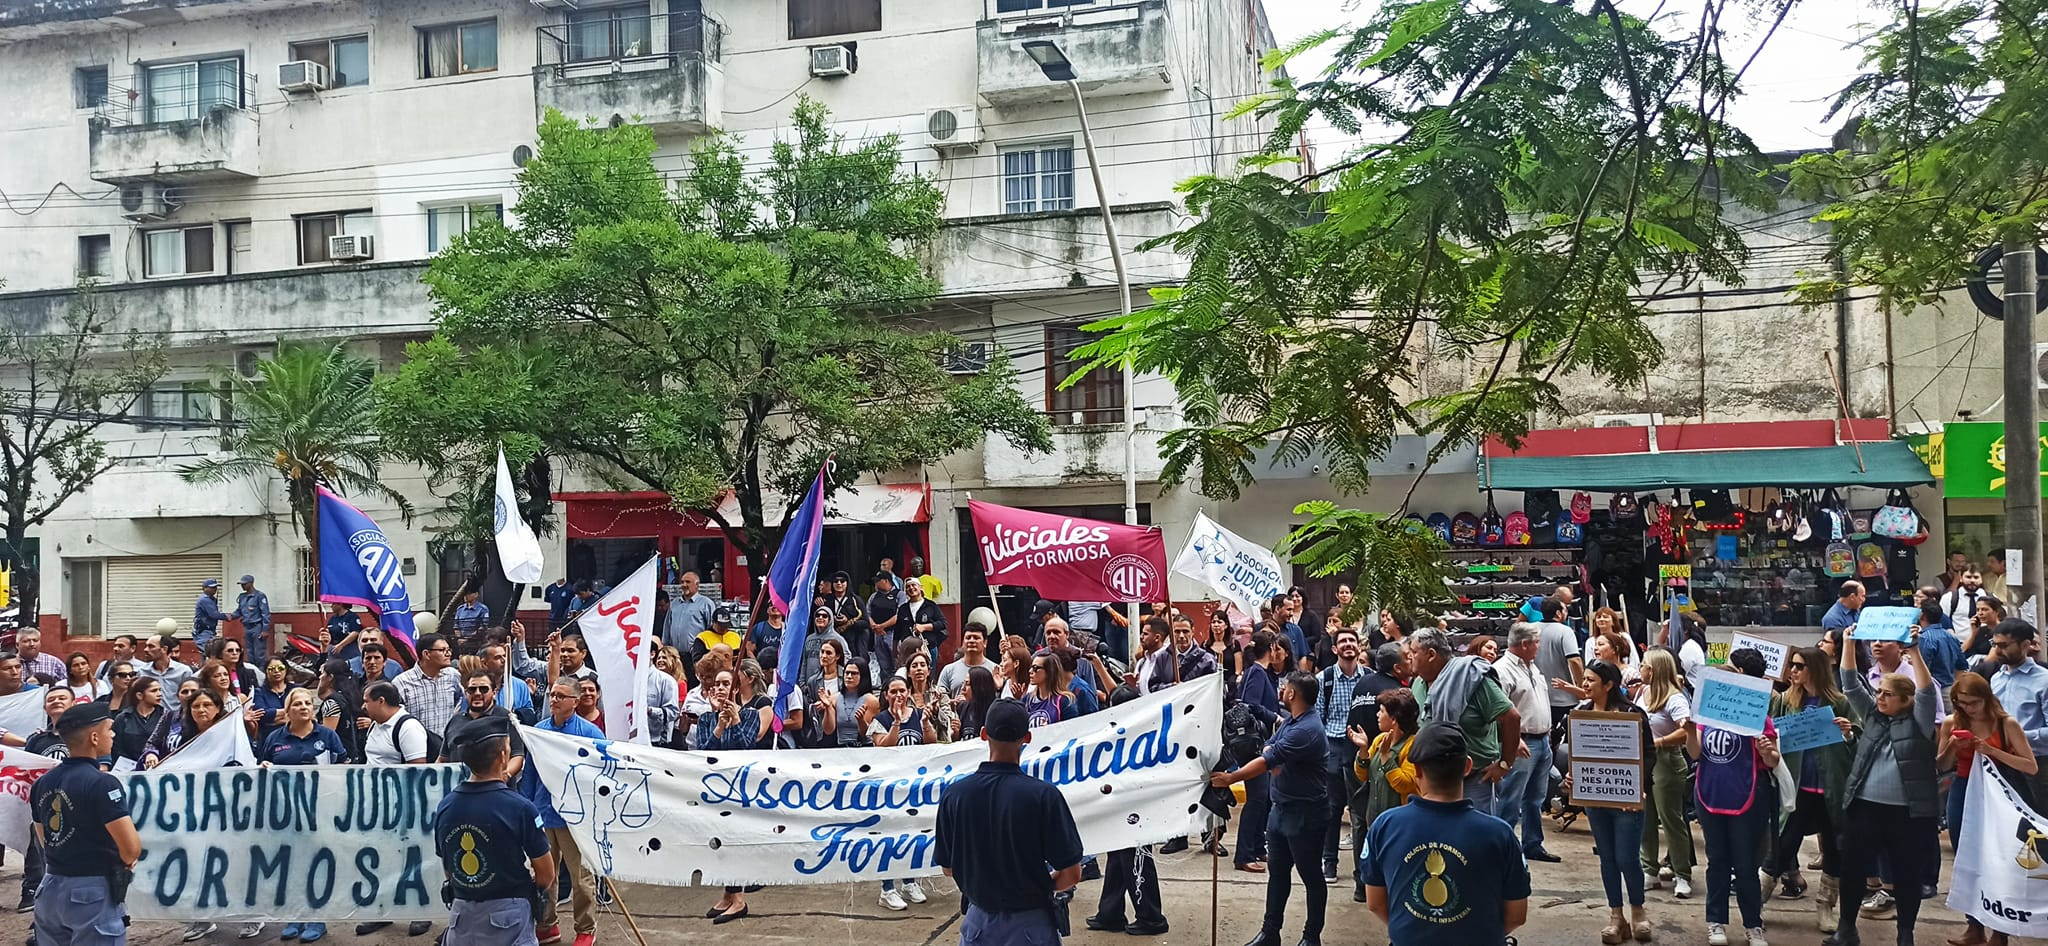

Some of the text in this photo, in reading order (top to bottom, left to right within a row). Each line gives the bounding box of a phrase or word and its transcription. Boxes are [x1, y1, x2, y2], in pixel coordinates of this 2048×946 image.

[1025, 543, 1111, 569] FORMOSA
[1235, 551, 1283, 585] ASOCIACI
[1220, 575, 1260, 606] FORMO
[1227, 562, 1278, 599] JUDICIA
[1754, 643, 1780, 655] SOBRA
[1764, 654, 1778, 663] FIN
[701, 703, 1180, 811] Asociació udicial
[1582, 776, 1602, 784] MES
[1614, 778, 1632, 786] FIN
[1598, 768, 1632, 776] SOBRA
[128, 766, 454, 834] OCIACION JUDICI
[1595, 786, 1635, 796] SUELDO
[1403, 843, 1427, 863] POLICIA
[1439, 843, 1468, 866] FORMOSA
[139, 844, 430, 909] ORMOSA
